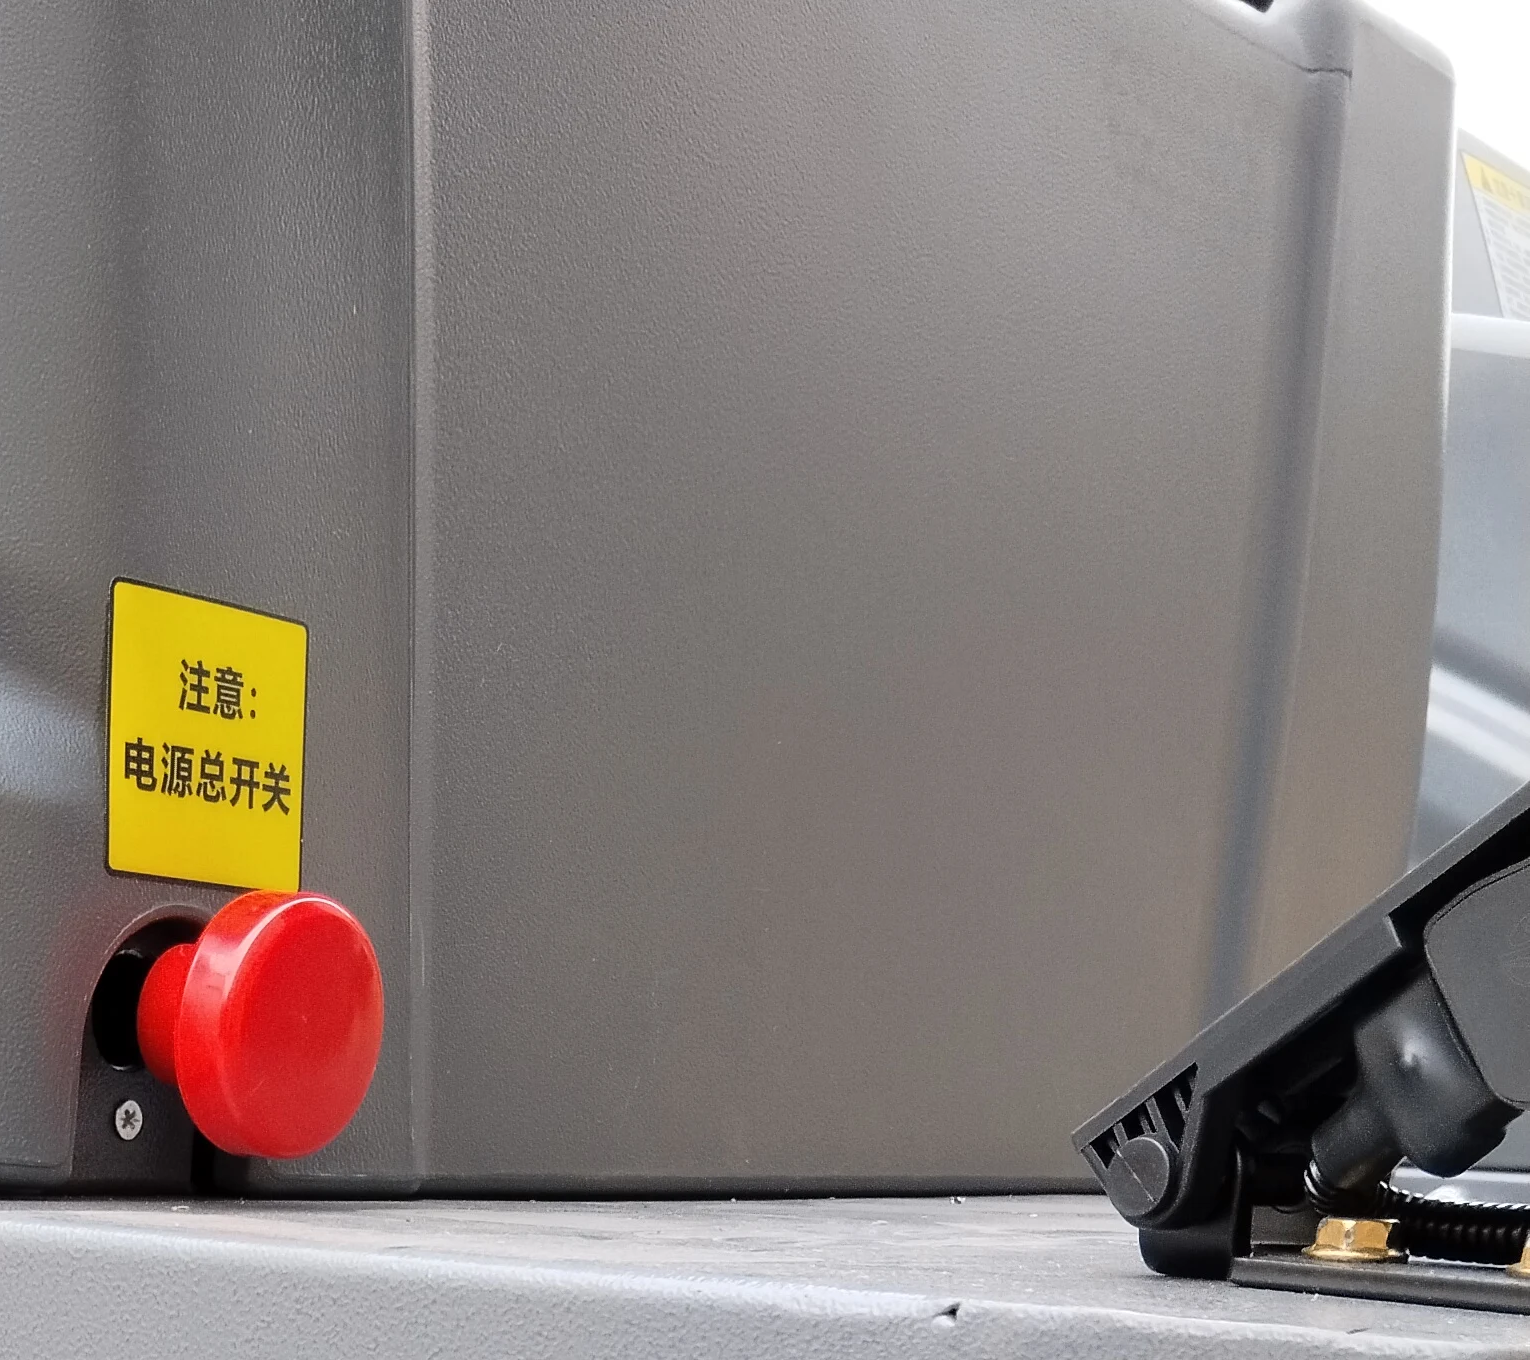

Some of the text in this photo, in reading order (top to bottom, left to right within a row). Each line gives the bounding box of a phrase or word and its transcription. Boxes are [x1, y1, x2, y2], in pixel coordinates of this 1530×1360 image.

[179, 660, 257, 720] 注意：
[124, 737, 291, 815] 电源总开关
